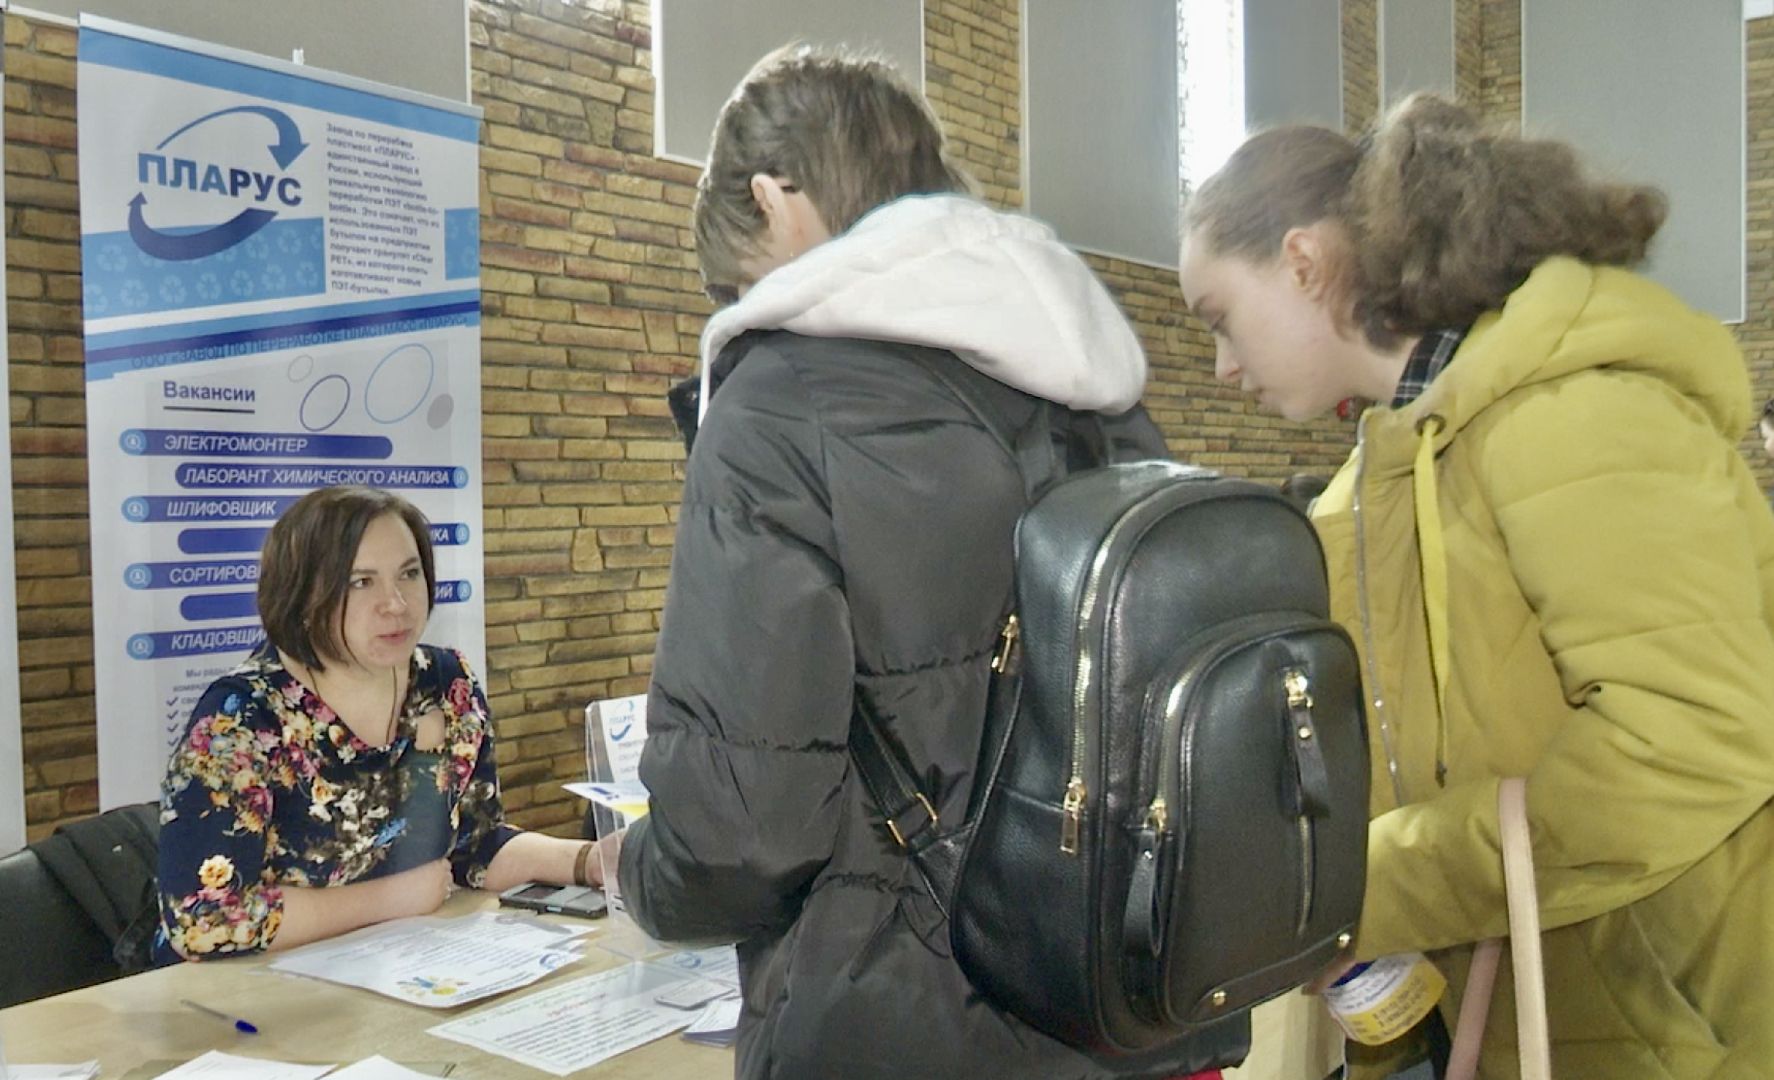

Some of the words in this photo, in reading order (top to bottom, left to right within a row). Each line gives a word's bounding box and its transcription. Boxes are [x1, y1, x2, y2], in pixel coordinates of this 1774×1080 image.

[138, 152, 302, 208] ПЛАРУС
[384, 198, 401, 208] ПЭТ
[403, 225, 418, 236] ПЭТ
[163, 380, 256, 403] Вакансии
[164, 434, 308, 453] ЭЛЕКТРОМОНТЕР
[184, 467, 270, 484] ЛАБОРАНТ
[272, 468, 385, 485] ХИМИЧЕСКОГО
[388, 469, 450, 485] АНАЛИЗА
[167, 499, 277, 518] ШЛИФОВЩИК
[169, 564, 261, 584] СОРТИРОВ
